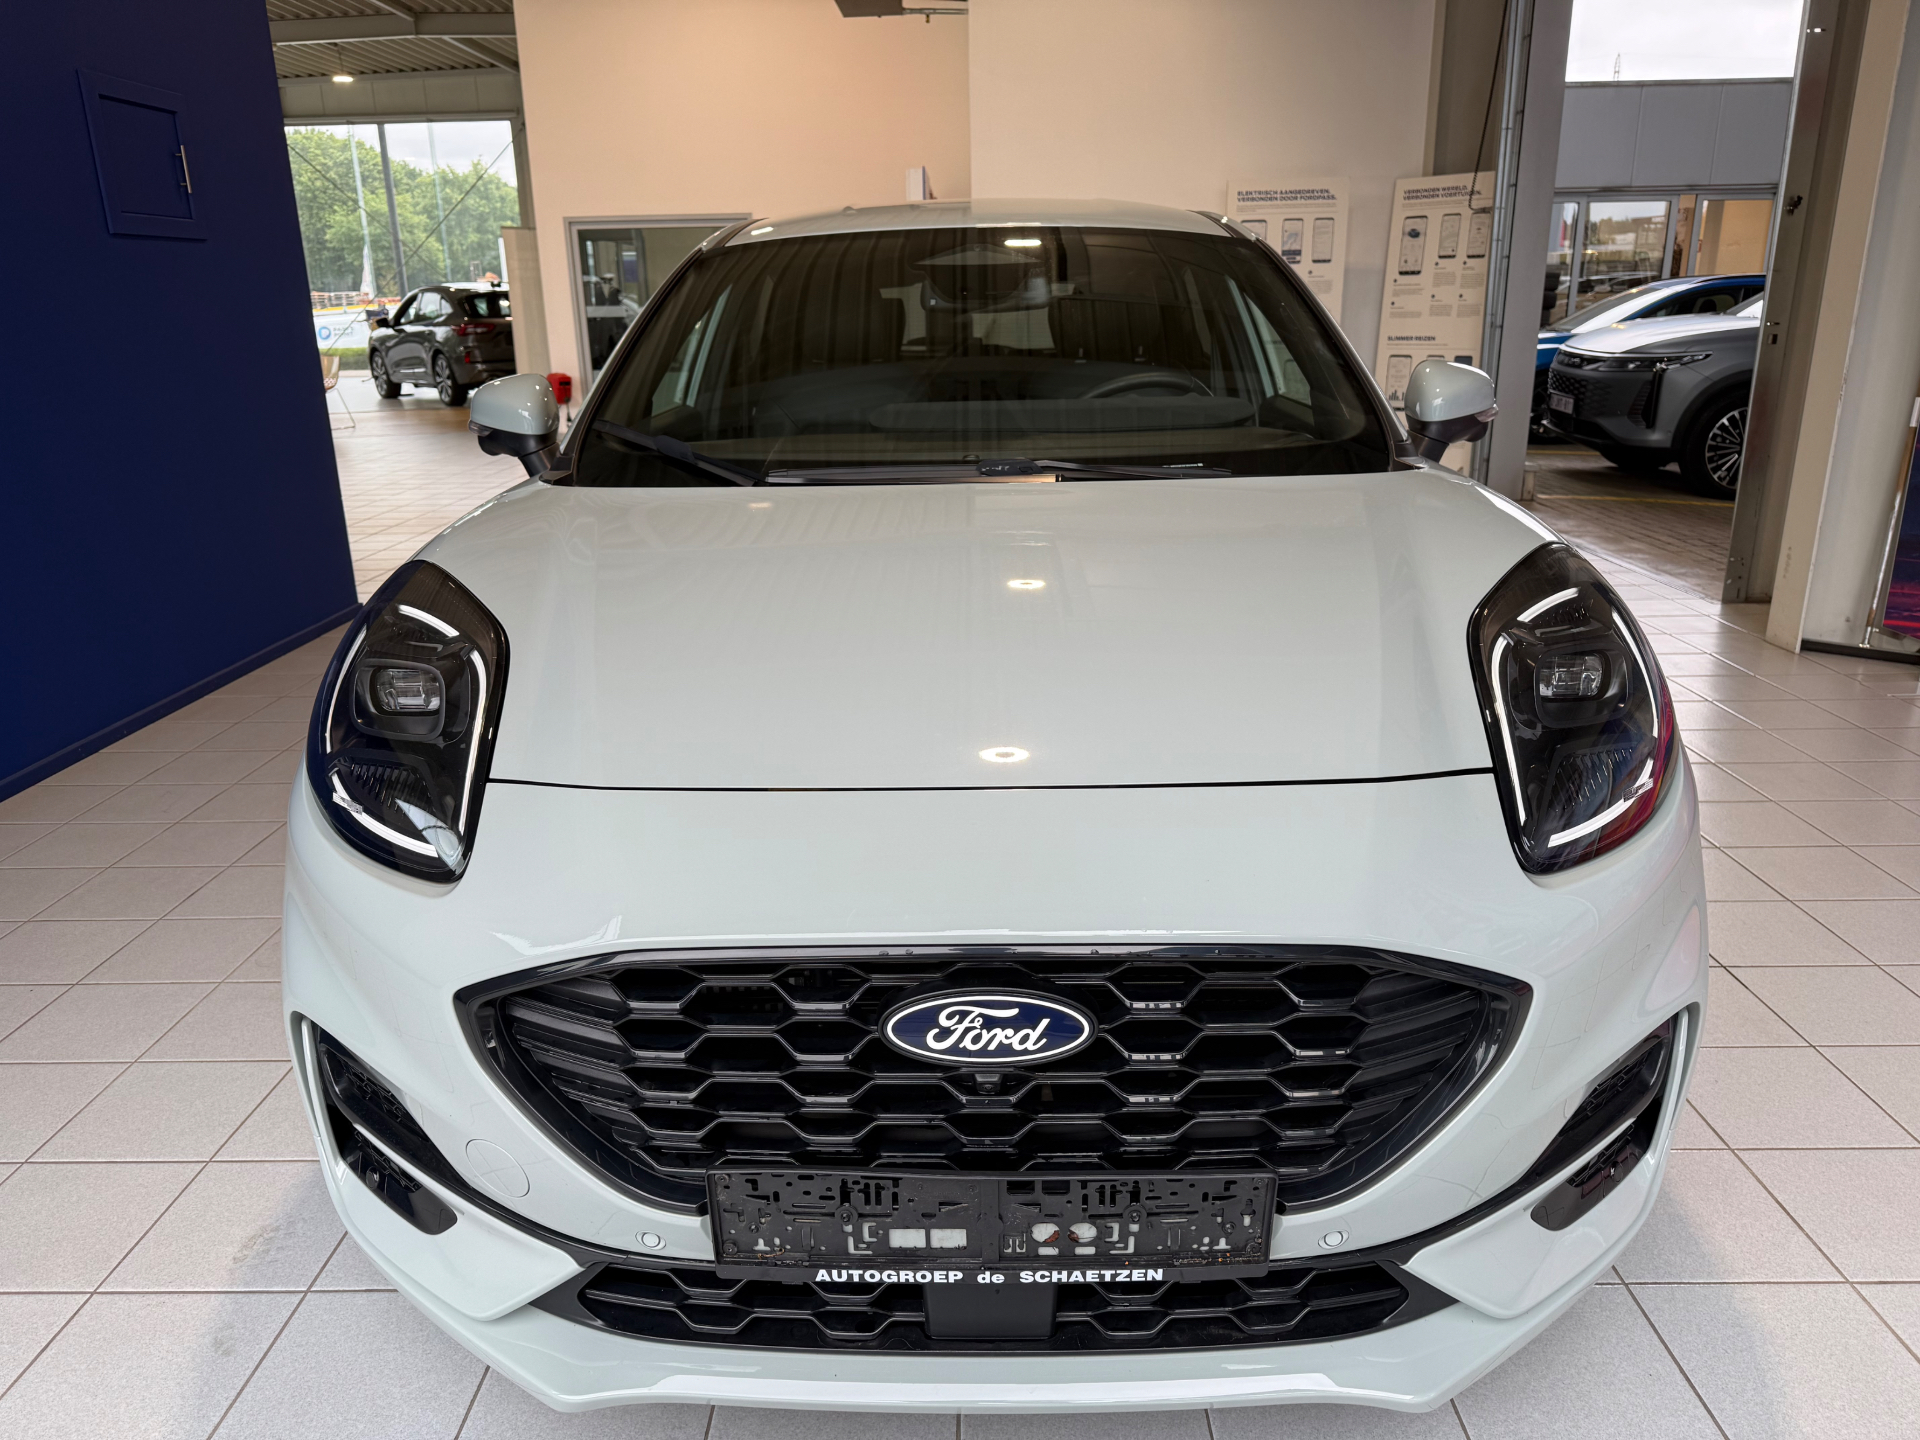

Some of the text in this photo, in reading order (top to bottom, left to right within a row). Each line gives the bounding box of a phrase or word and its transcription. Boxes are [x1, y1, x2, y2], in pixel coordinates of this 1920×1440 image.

[925, 1004, 1051, 1052] Ford
[815, 1268, 1163, 1284] AUTOGROEP de SCHAETZEN
